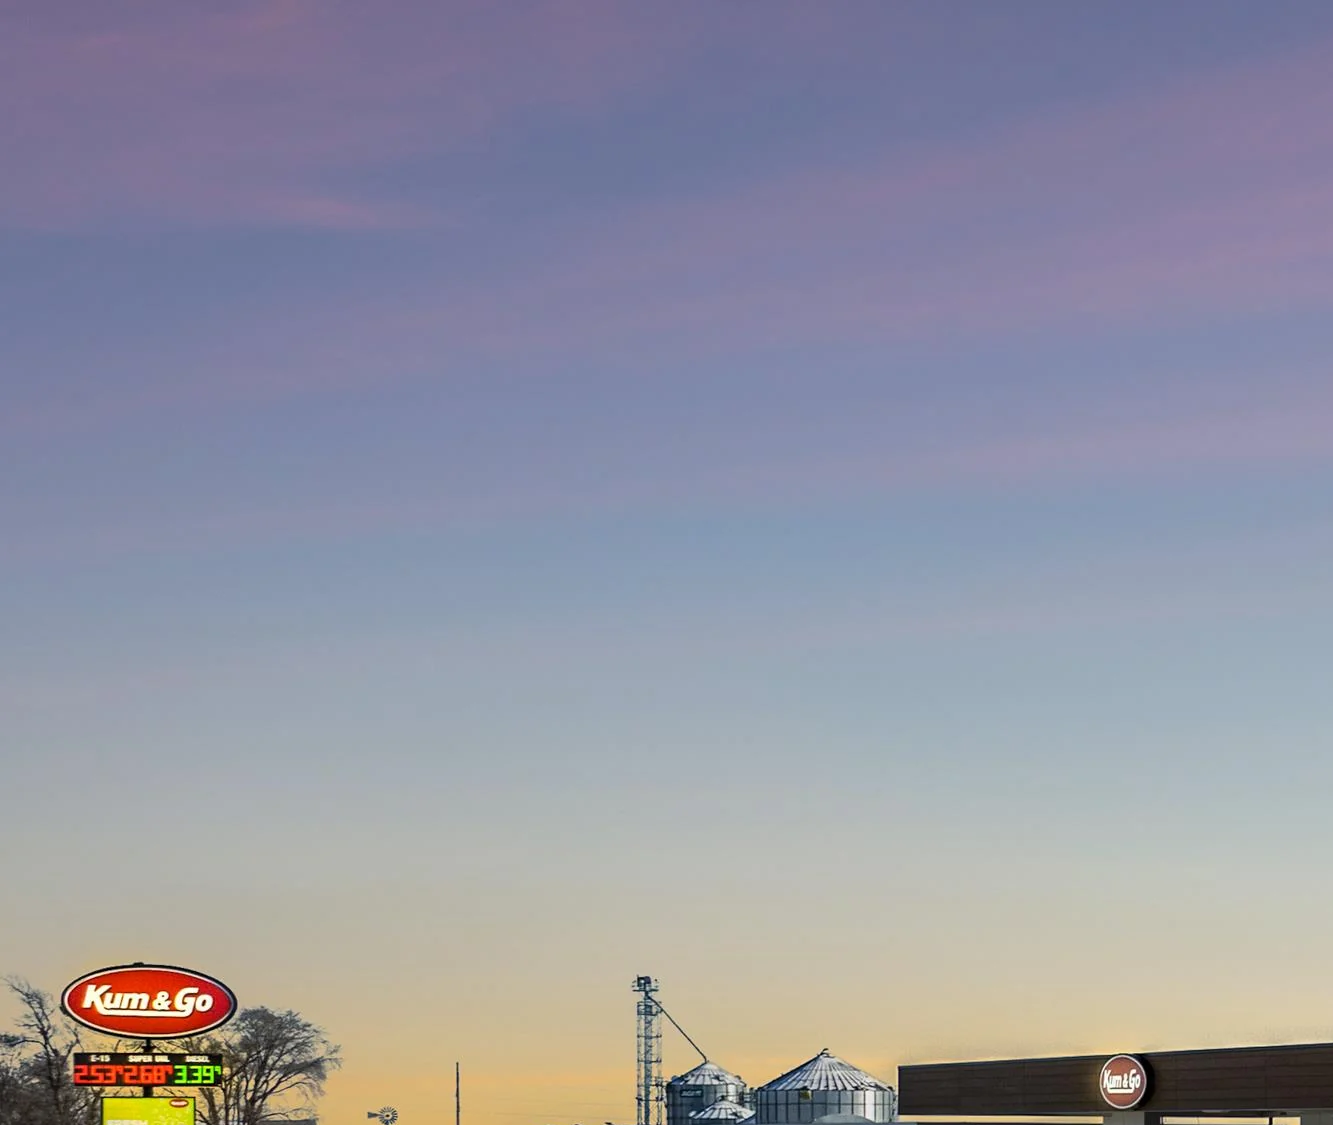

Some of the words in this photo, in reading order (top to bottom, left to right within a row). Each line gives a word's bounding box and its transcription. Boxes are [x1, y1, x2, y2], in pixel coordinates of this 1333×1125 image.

[82, 984, 150, 1016] Kum
[152, 990, 172, 1011] &
[174, 986, 214, 1017] Go
[90, 1054, 111, 1063] E-15
[185, 1055, 211, 1064] DIESEL
[1103, 1069, 1122, 1093] Kum
[1122, 1073, 1129, 1089] &
[1129, 1068, 1141, 1093] Go
